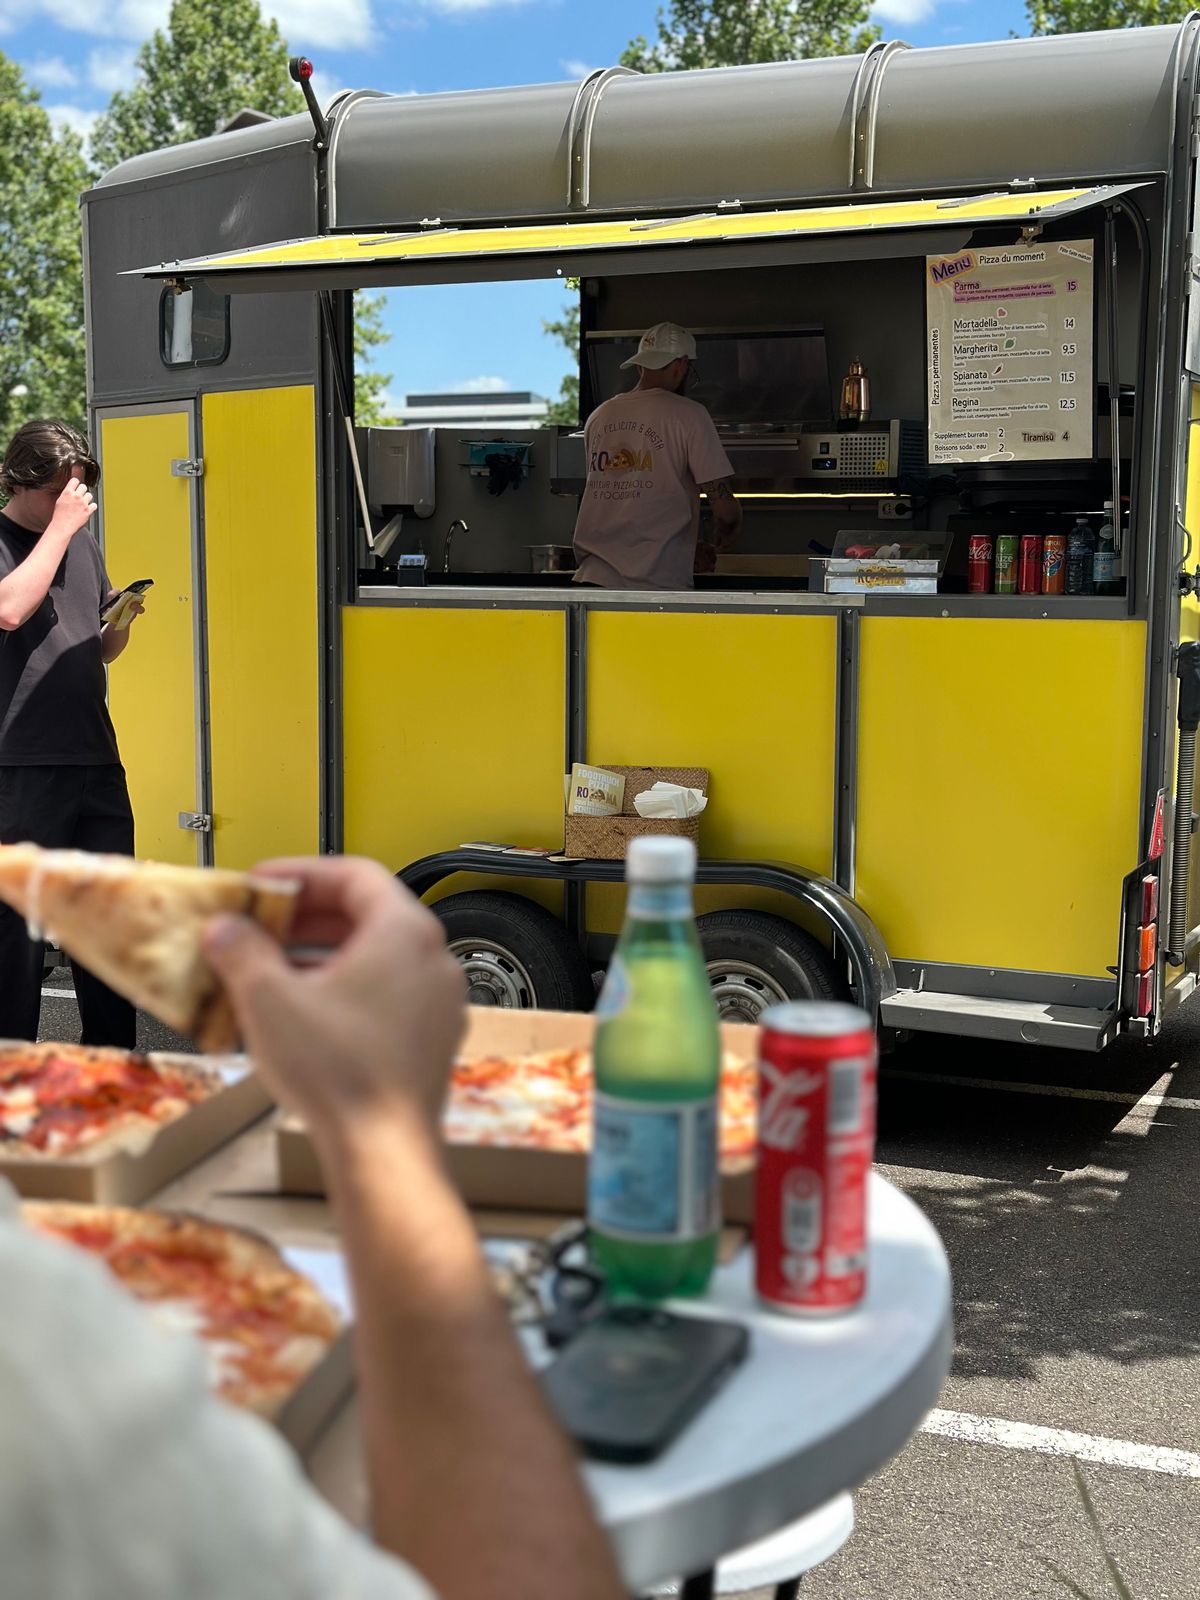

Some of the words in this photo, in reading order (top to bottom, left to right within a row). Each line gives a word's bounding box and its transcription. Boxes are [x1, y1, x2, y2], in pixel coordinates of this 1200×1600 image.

[979, 255, 1000, 264] Pizza
[1002, 254, 1011, 263] du
[1013, 253, 1044, 262] moment
[932, 256, 971, 281] Menu
[954, 281, 980, 291] Parma
[1067, 281, 1076, 291] 15
[953, 318, 998, 329] Mortadella
[1065, 318, 1074, 328] 14
[932, 329, 941, 379] permanentes
[953, 343, 998, 356] Margherita
[953, 371, 988, 382] Spianata
[931, 380, 940, 405] Pizzas
[952, 398, 979, 409] Regina
[935, 431, 967, 440] Supplément
[967, 431, 988, 439] burrata
[998, 428, 1004, 438] 2
[1062, 431, 1069, 441] 4
[959, 443, 973, 451] soda
[998, 443, 1005, 453] 2
